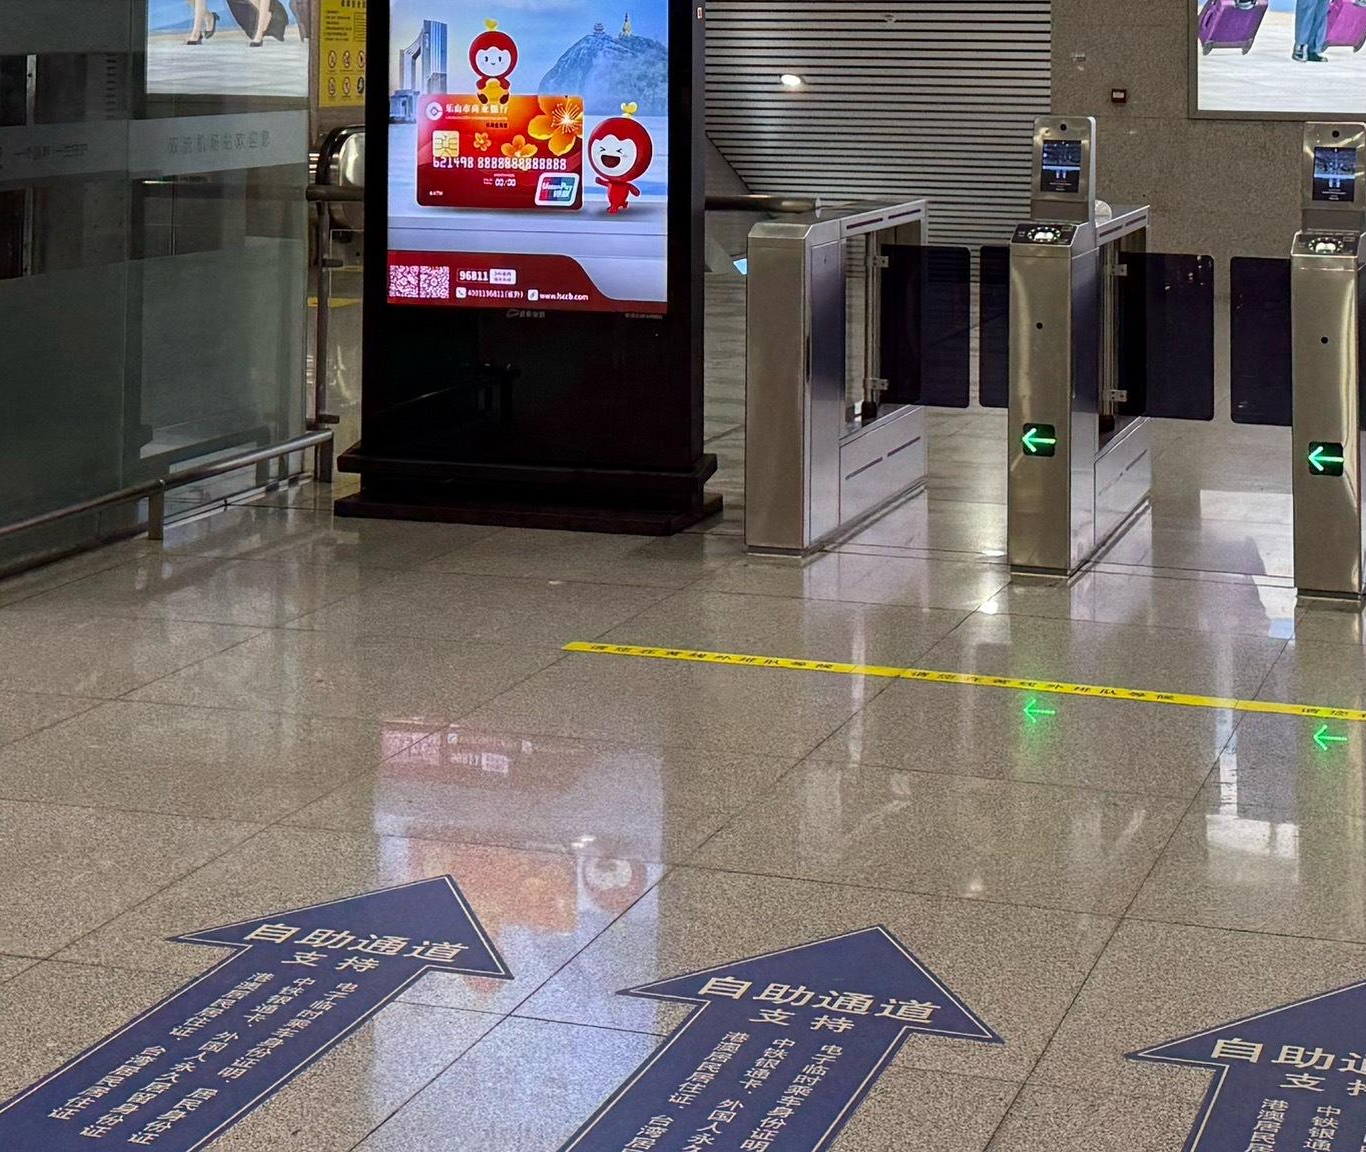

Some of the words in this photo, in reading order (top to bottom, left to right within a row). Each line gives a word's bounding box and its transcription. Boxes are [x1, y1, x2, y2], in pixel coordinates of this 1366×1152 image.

[243, 922, 470, 965] 自助通道
[281, 950, 380, 974] 支持
[698, 975, 942, 1025] 自助通道
[749, 1008, 855, 1034] 支持
[1302, 1105, 1341, 1152] 中铁银通
